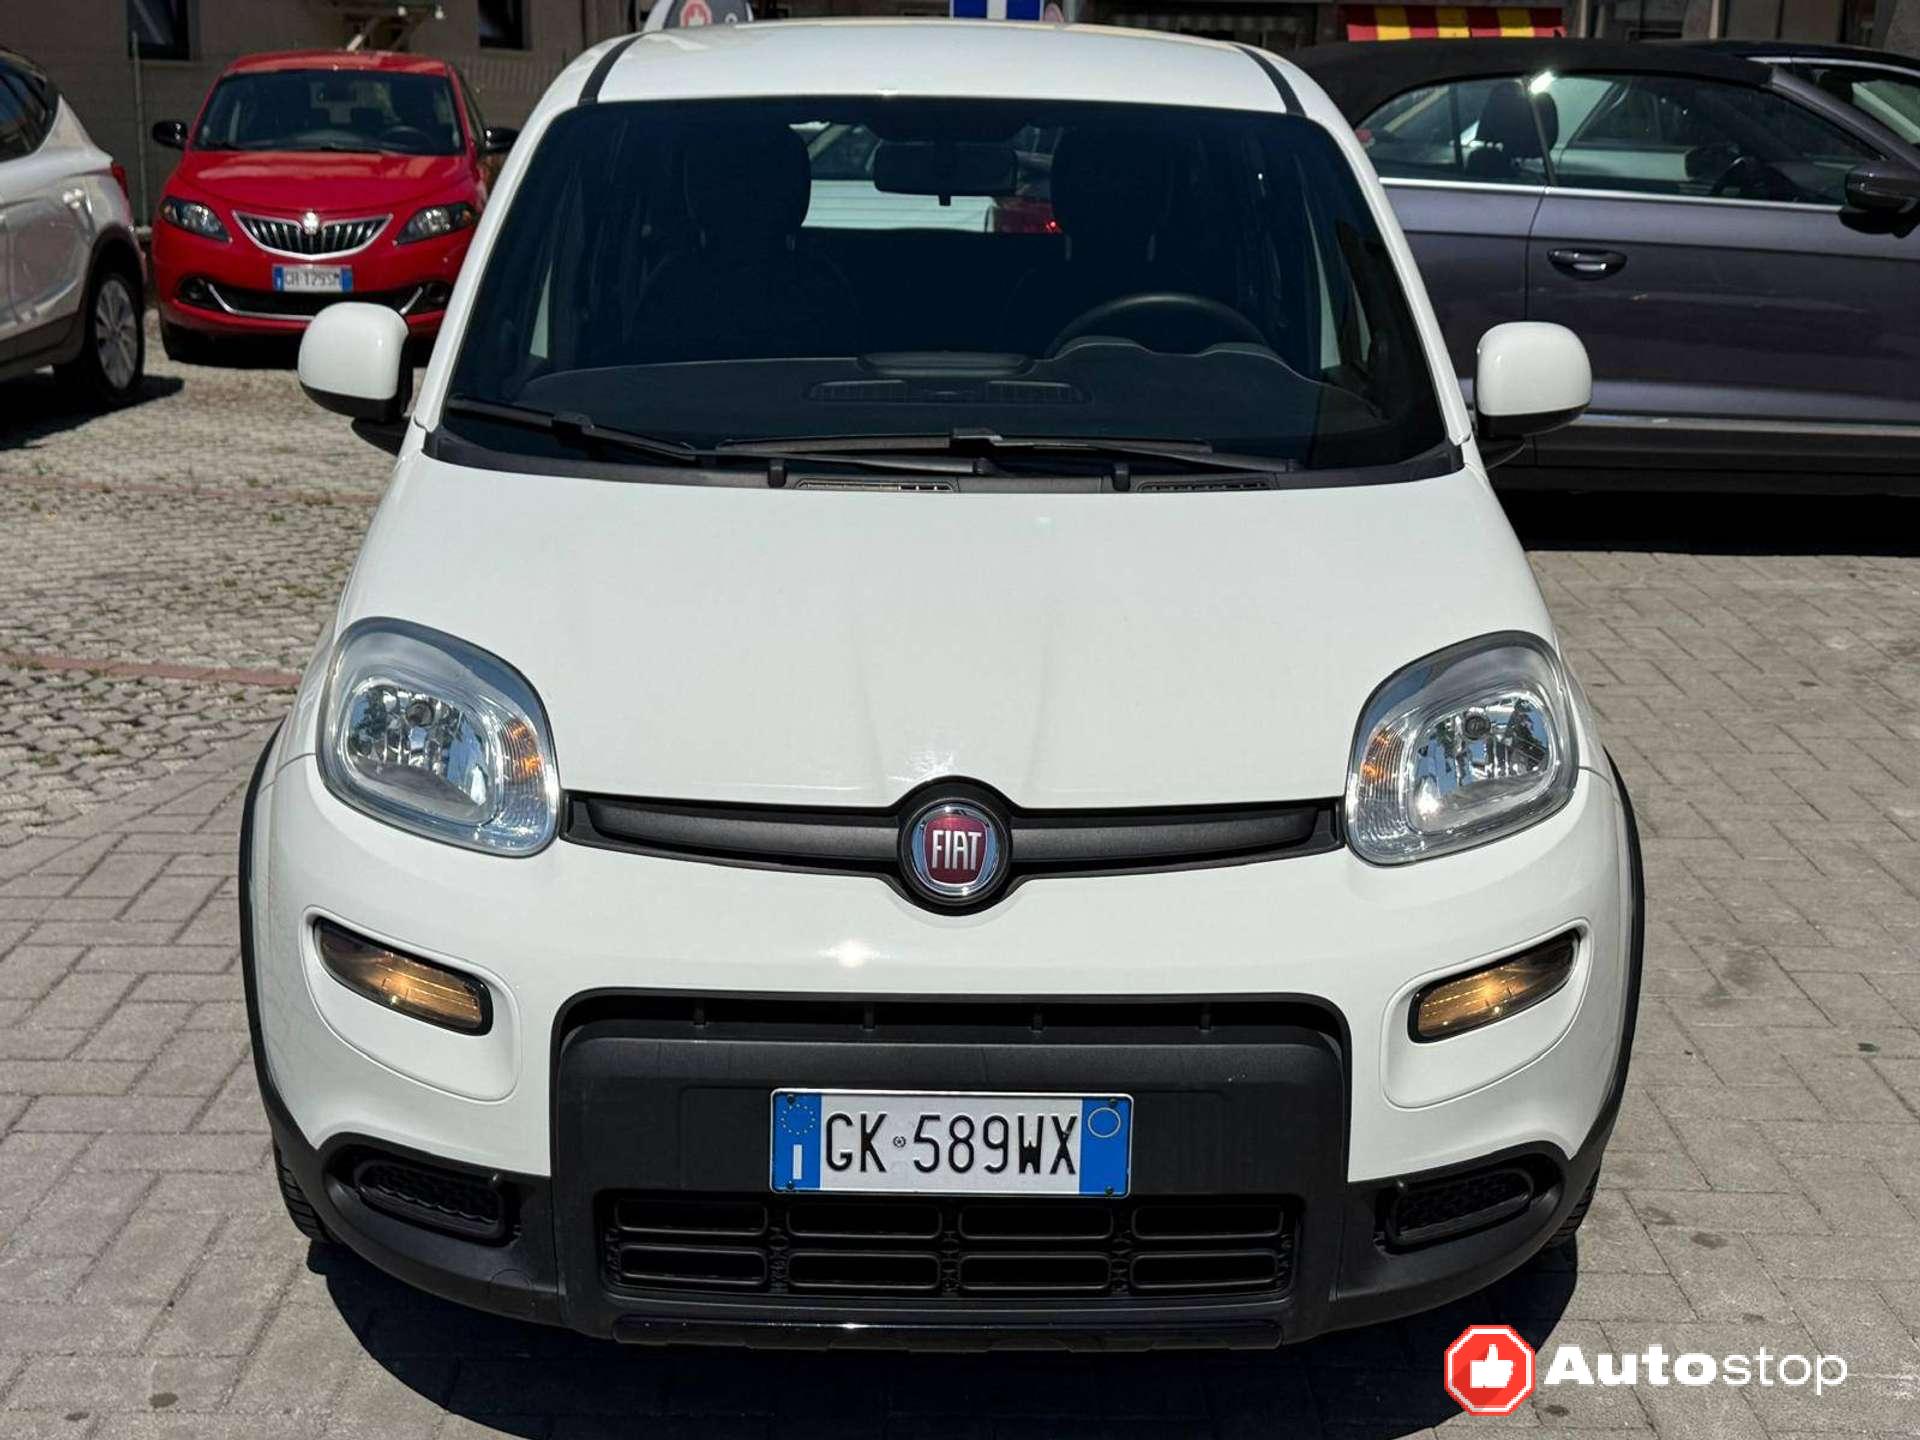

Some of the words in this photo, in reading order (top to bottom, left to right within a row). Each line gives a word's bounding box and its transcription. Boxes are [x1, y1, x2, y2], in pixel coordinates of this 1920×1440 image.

[931, 829, 982, 870] FIAT
[825, 1113, 886, 1173] GK
[913, 1114, 1077, 1175] 589WX
